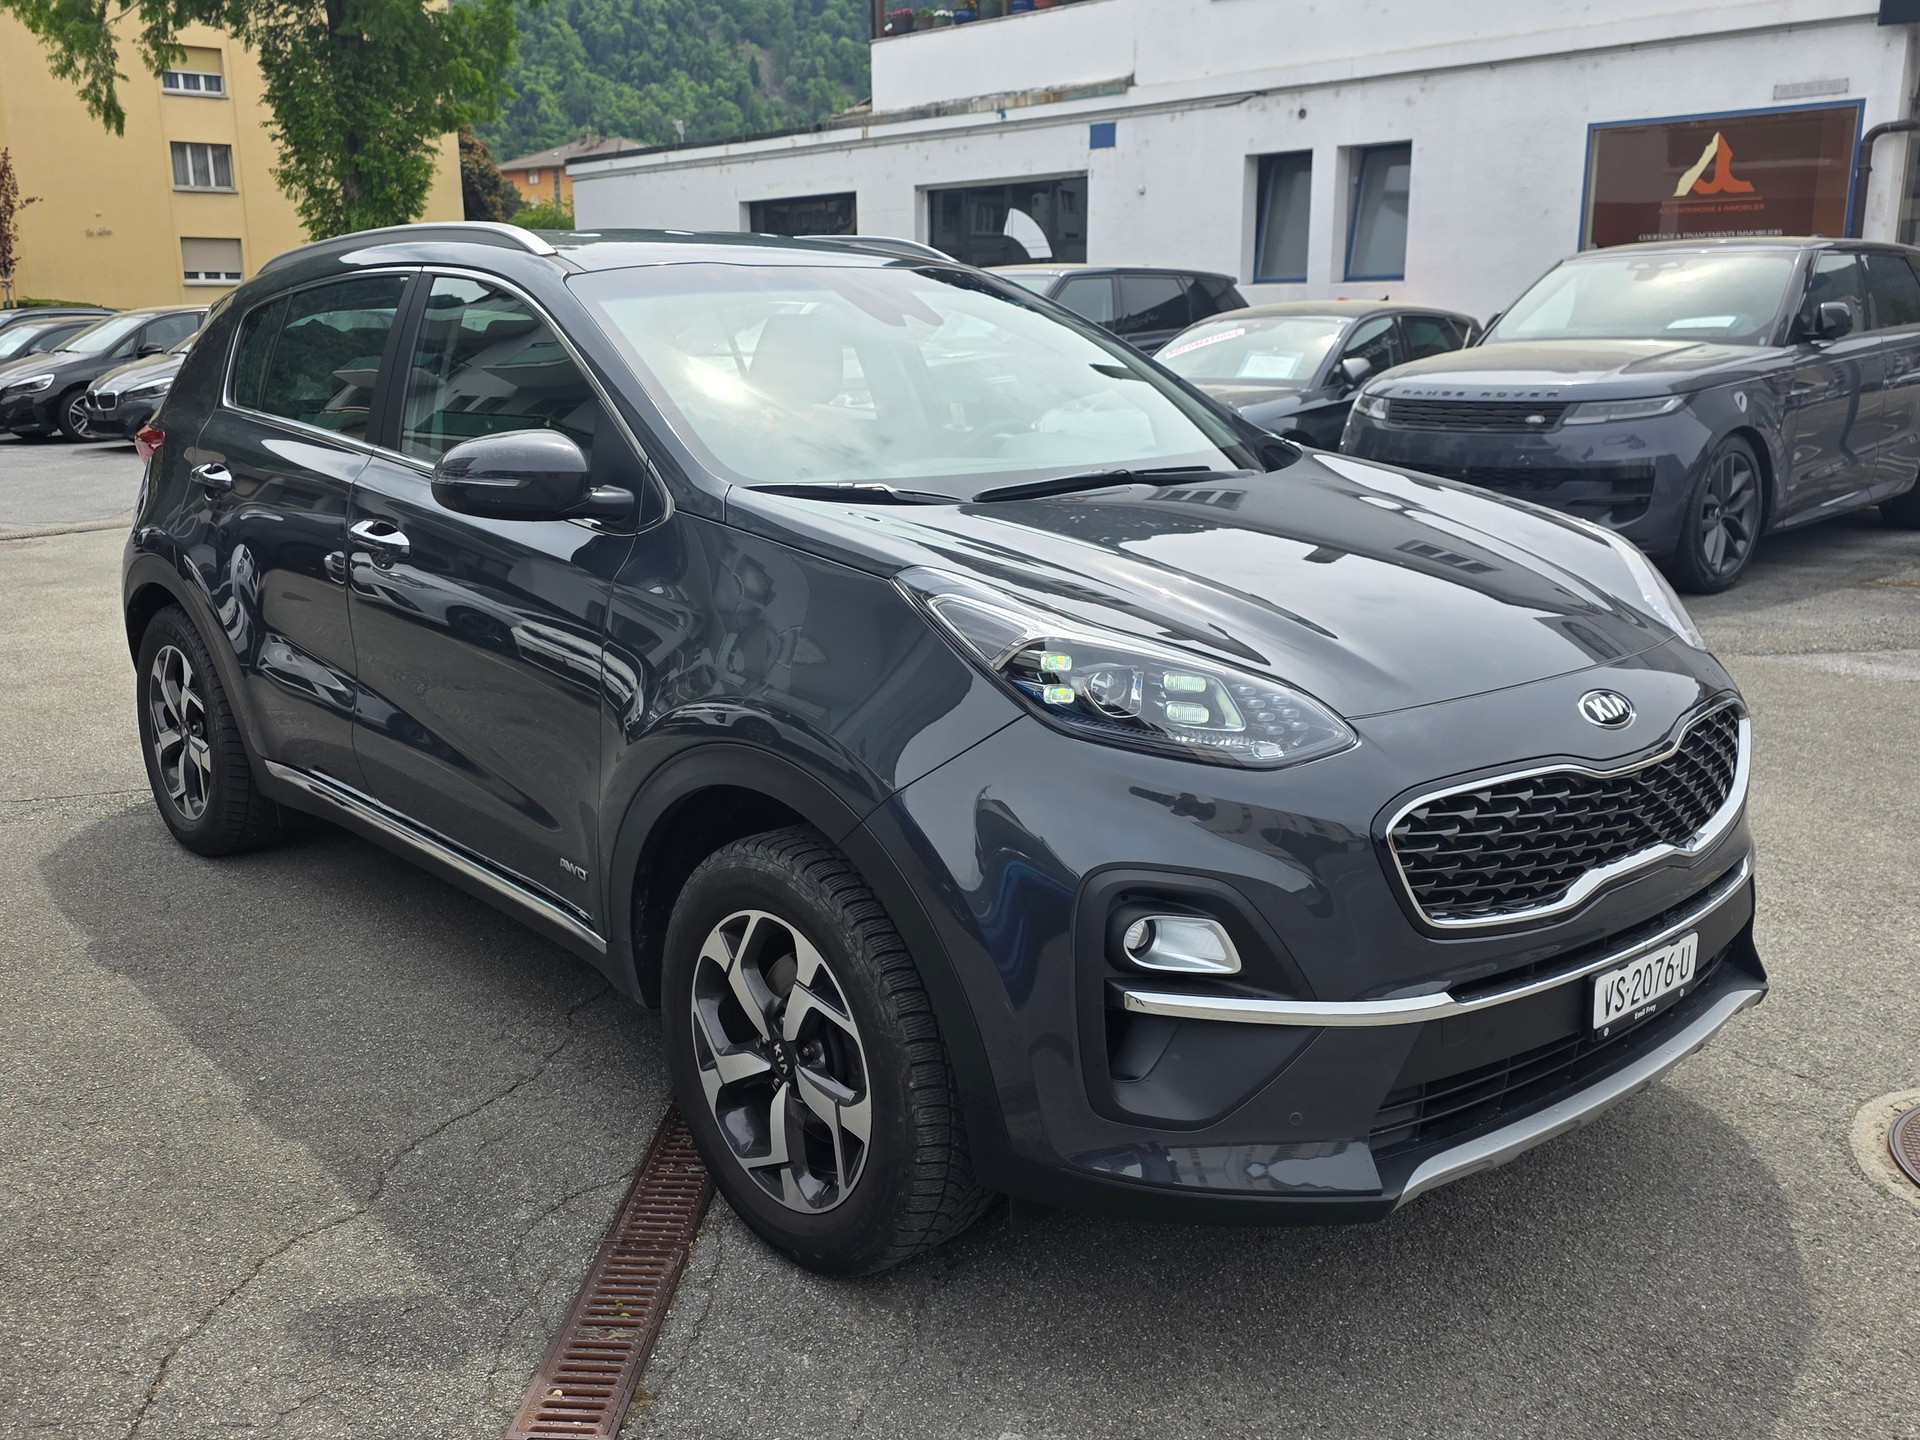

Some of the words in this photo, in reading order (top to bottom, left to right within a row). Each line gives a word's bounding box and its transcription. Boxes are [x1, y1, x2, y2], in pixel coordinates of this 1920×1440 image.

[1402, 389, 1466, 398] RANGE
[1480, 389, 1559, 399] ROVER
[1585, 694, 1630, 722] KIA
[559, 857, 588, 882] AWD
[1634, 1007, 1645, 1020] Emil
[1646, 1003, 1657, 1016] Frey
[773, 1042, 789, 1075] KIA
